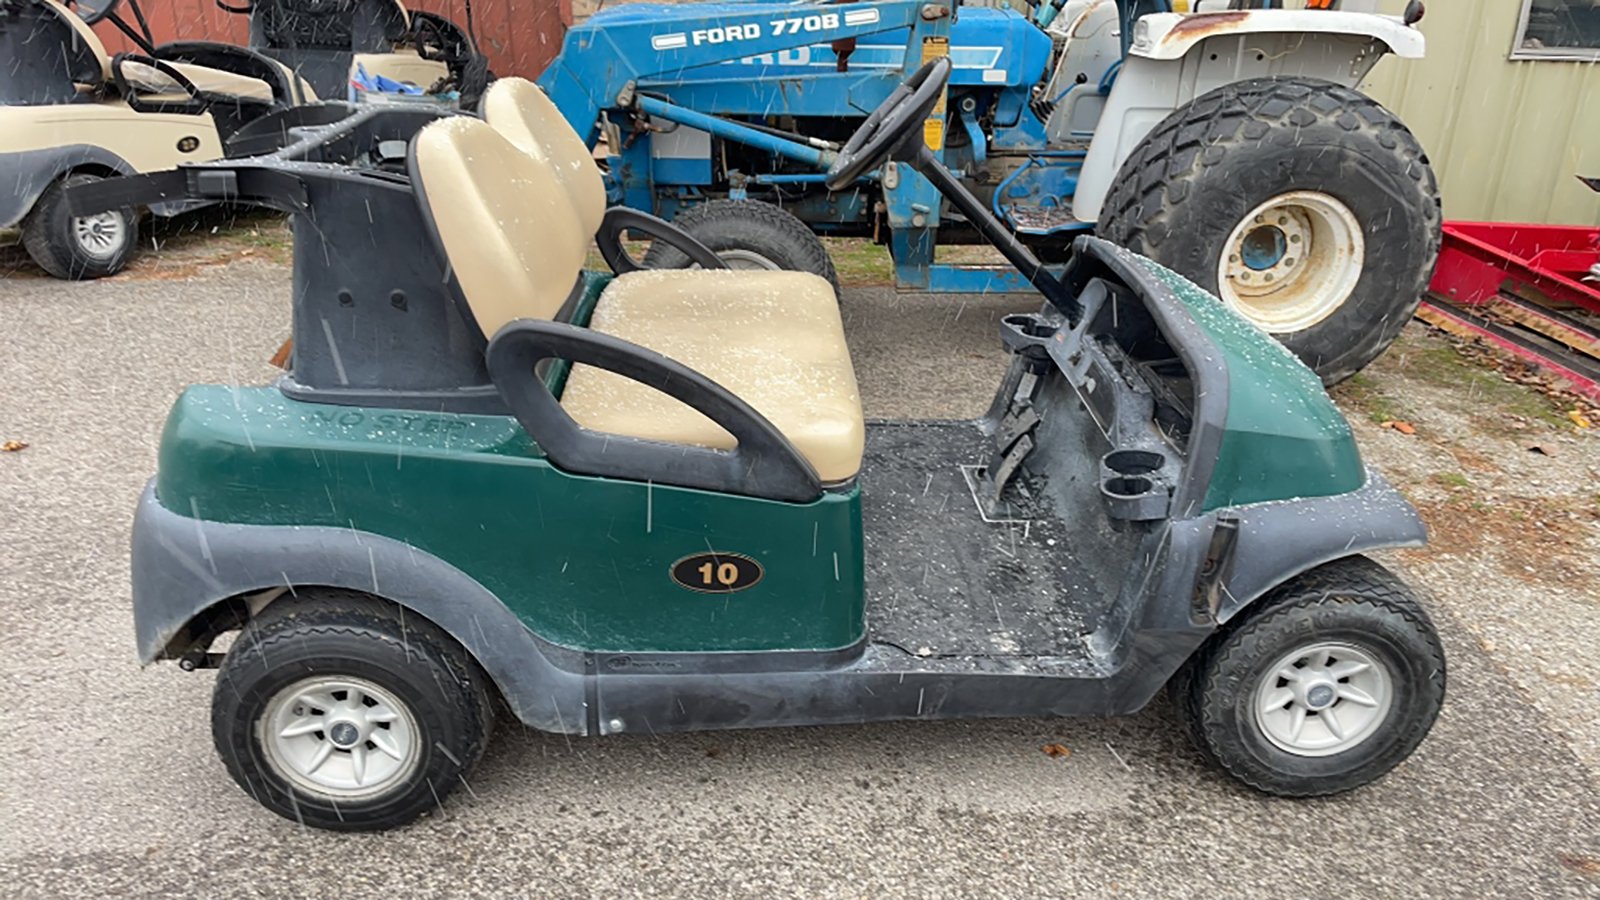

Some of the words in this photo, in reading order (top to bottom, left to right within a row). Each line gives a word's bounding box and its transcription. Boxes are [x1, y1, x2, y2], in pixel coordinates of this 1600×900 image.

[692, 23, 761, 46] FORD
[769, 13, 840, 36] 770B
[698, 562, 739, 585] 10
